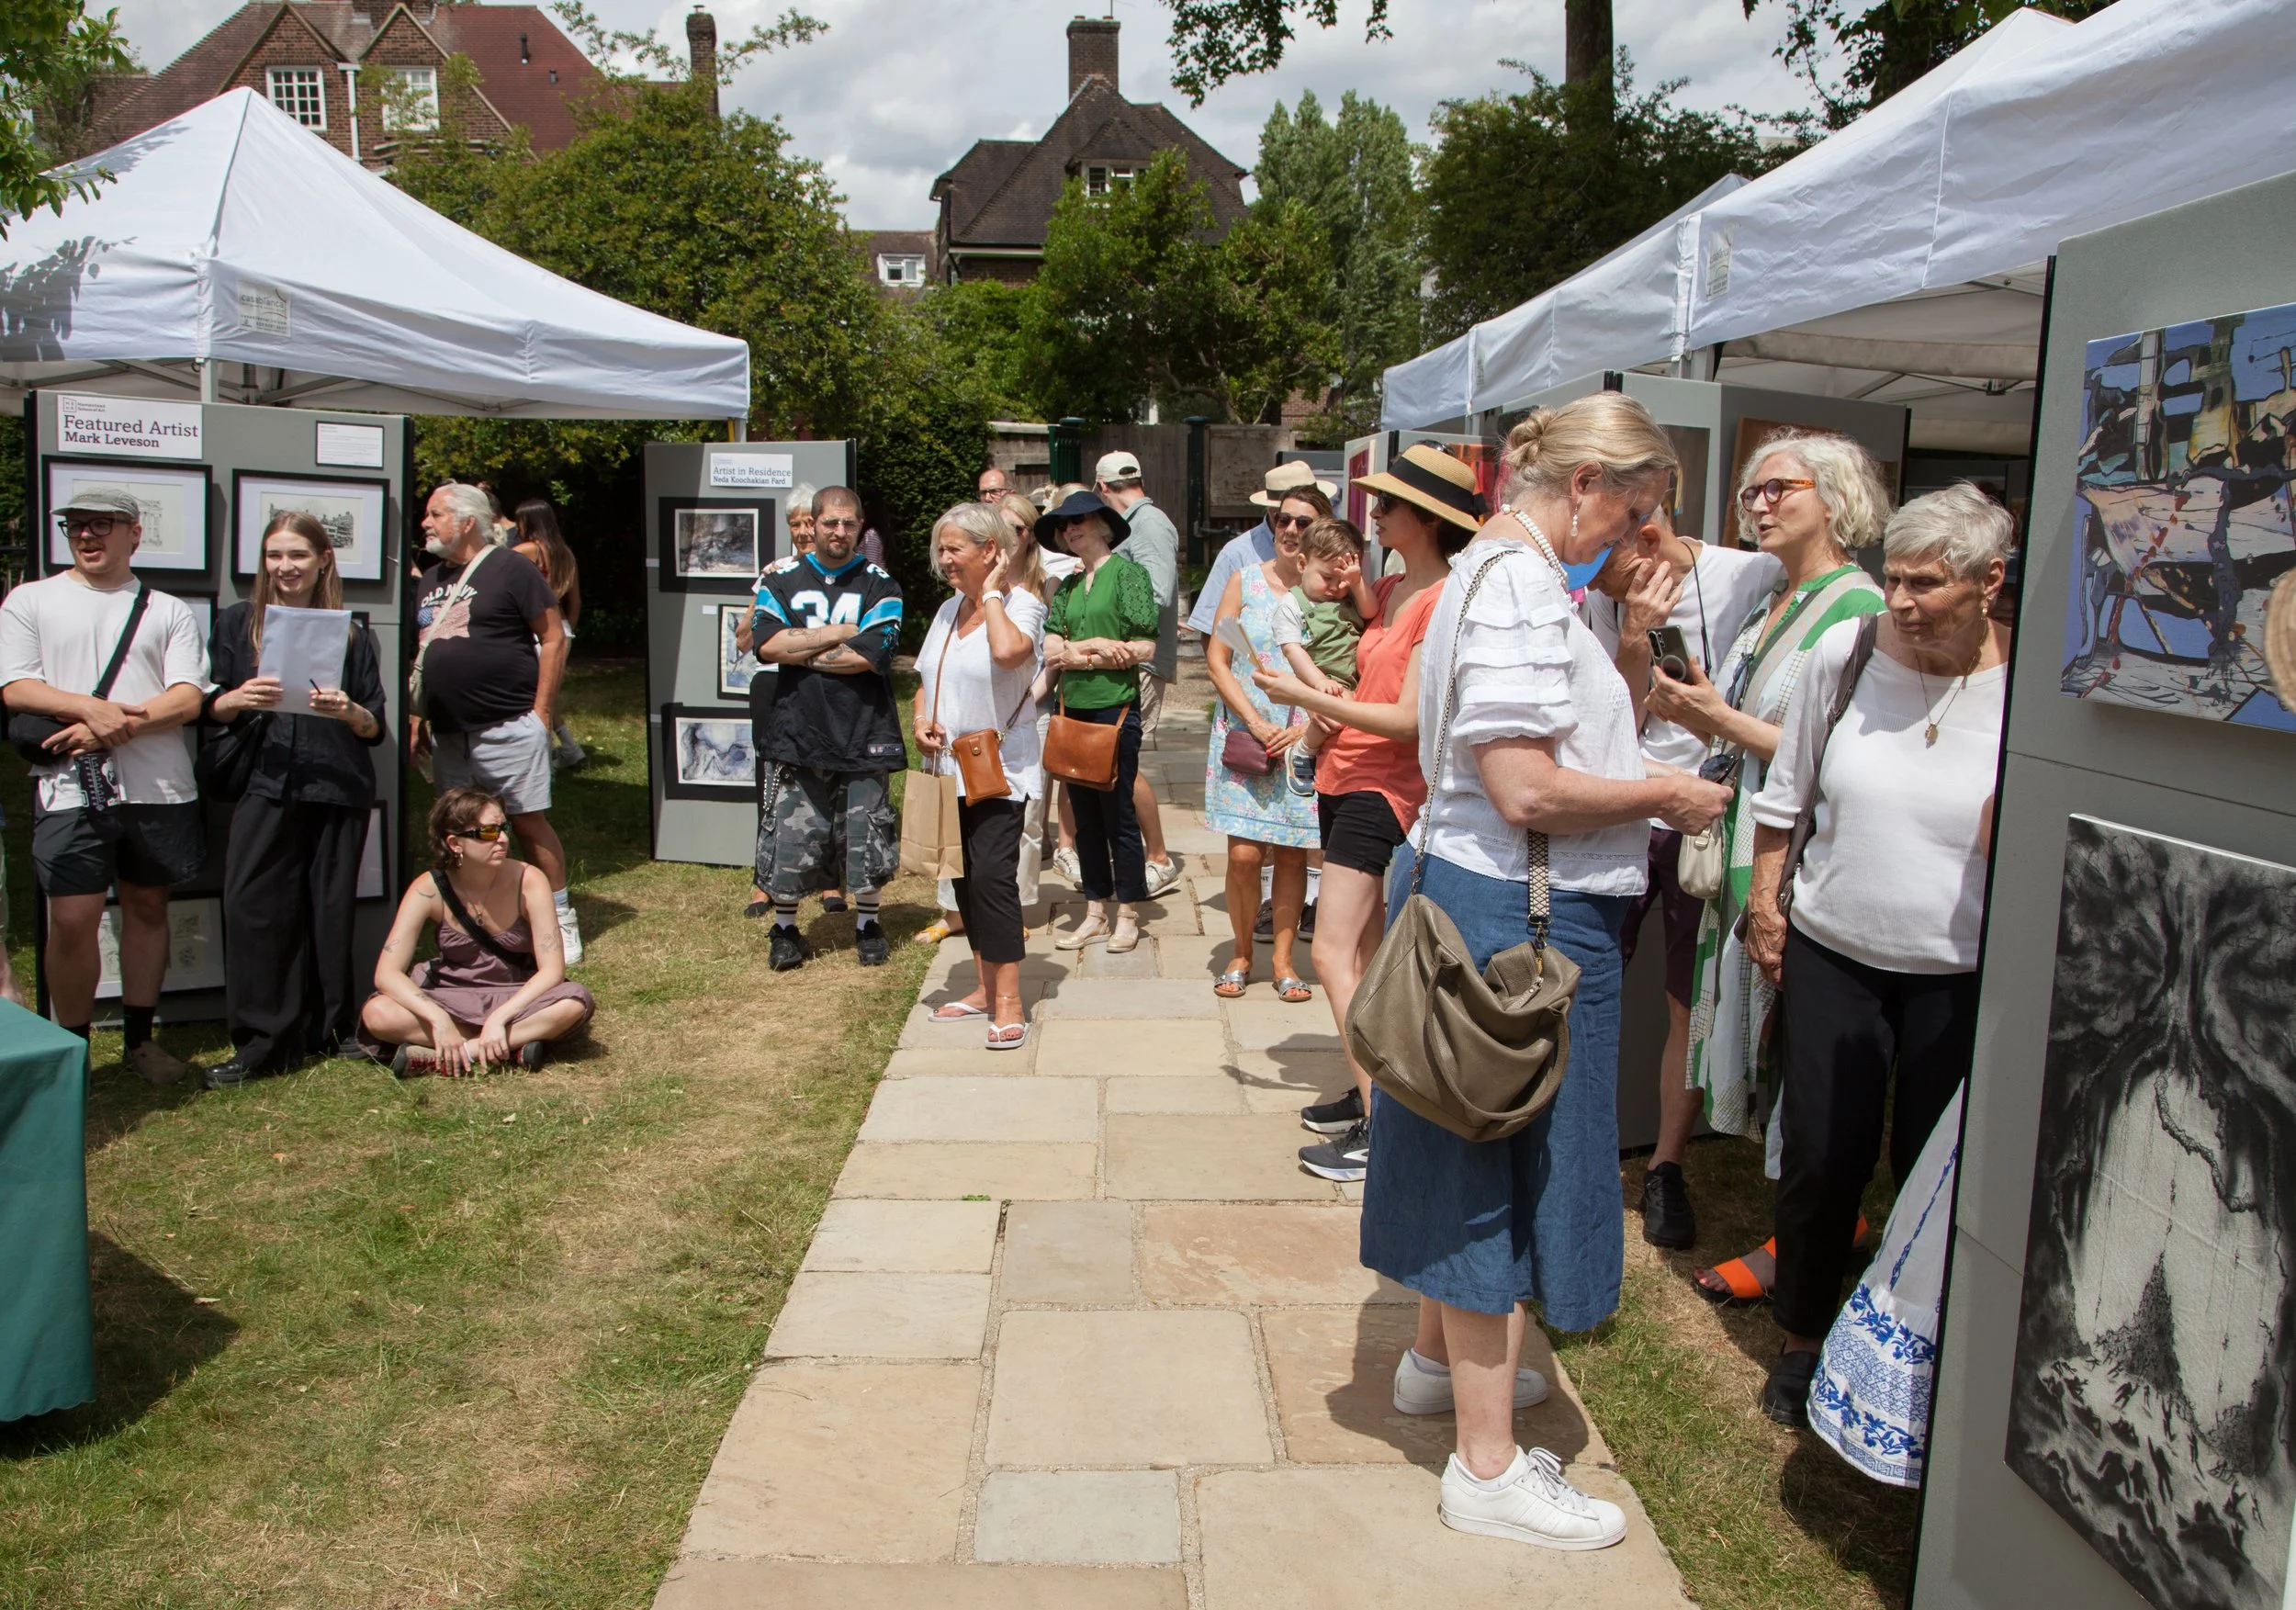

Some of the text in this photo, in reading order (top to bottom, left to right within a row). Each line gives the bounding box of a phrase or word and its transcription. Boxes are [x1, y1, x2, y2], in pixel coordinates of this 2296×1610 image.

[63, 414, 198, 437] Featured Artist
[64, 431, 160, 448] Mark Leveson
[713, 466, 792, 477] Artist in Residence
[730, 476, 770, 484] Koochakian
[771, 477, 786, 485] Fard
[421, 583, 478, 607] OLD NVY
[791, 590, 862, 629] 34
